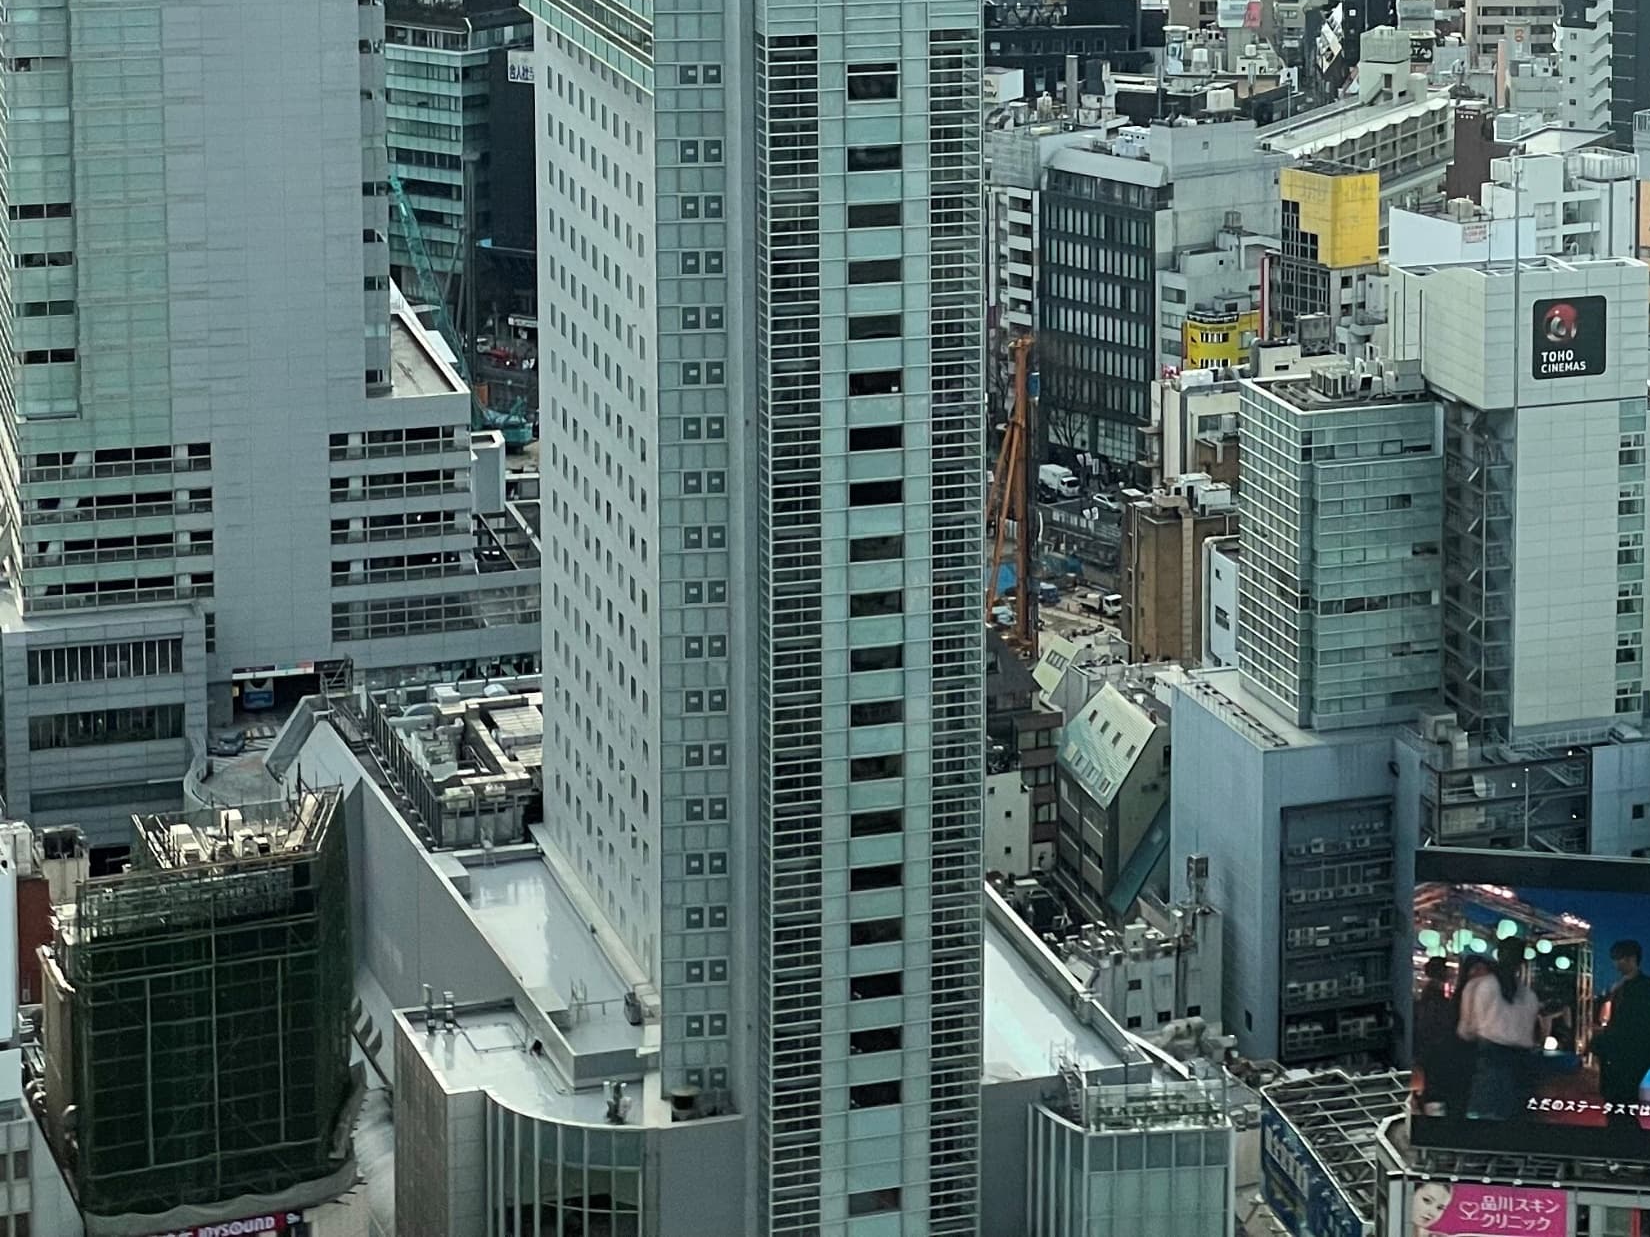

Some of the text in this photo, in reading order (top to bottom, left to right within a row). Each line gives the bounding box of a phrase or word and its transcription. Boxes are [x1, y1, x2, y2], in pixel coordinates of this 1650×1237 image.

[1540, 349, 1574, 363] TOHO
[1540, 361, 1587, 374] CINEMAS
[1480, 1195, 1561, 1214] 品川スキン
[1480, 1213, 1552, 1232] クリニック
